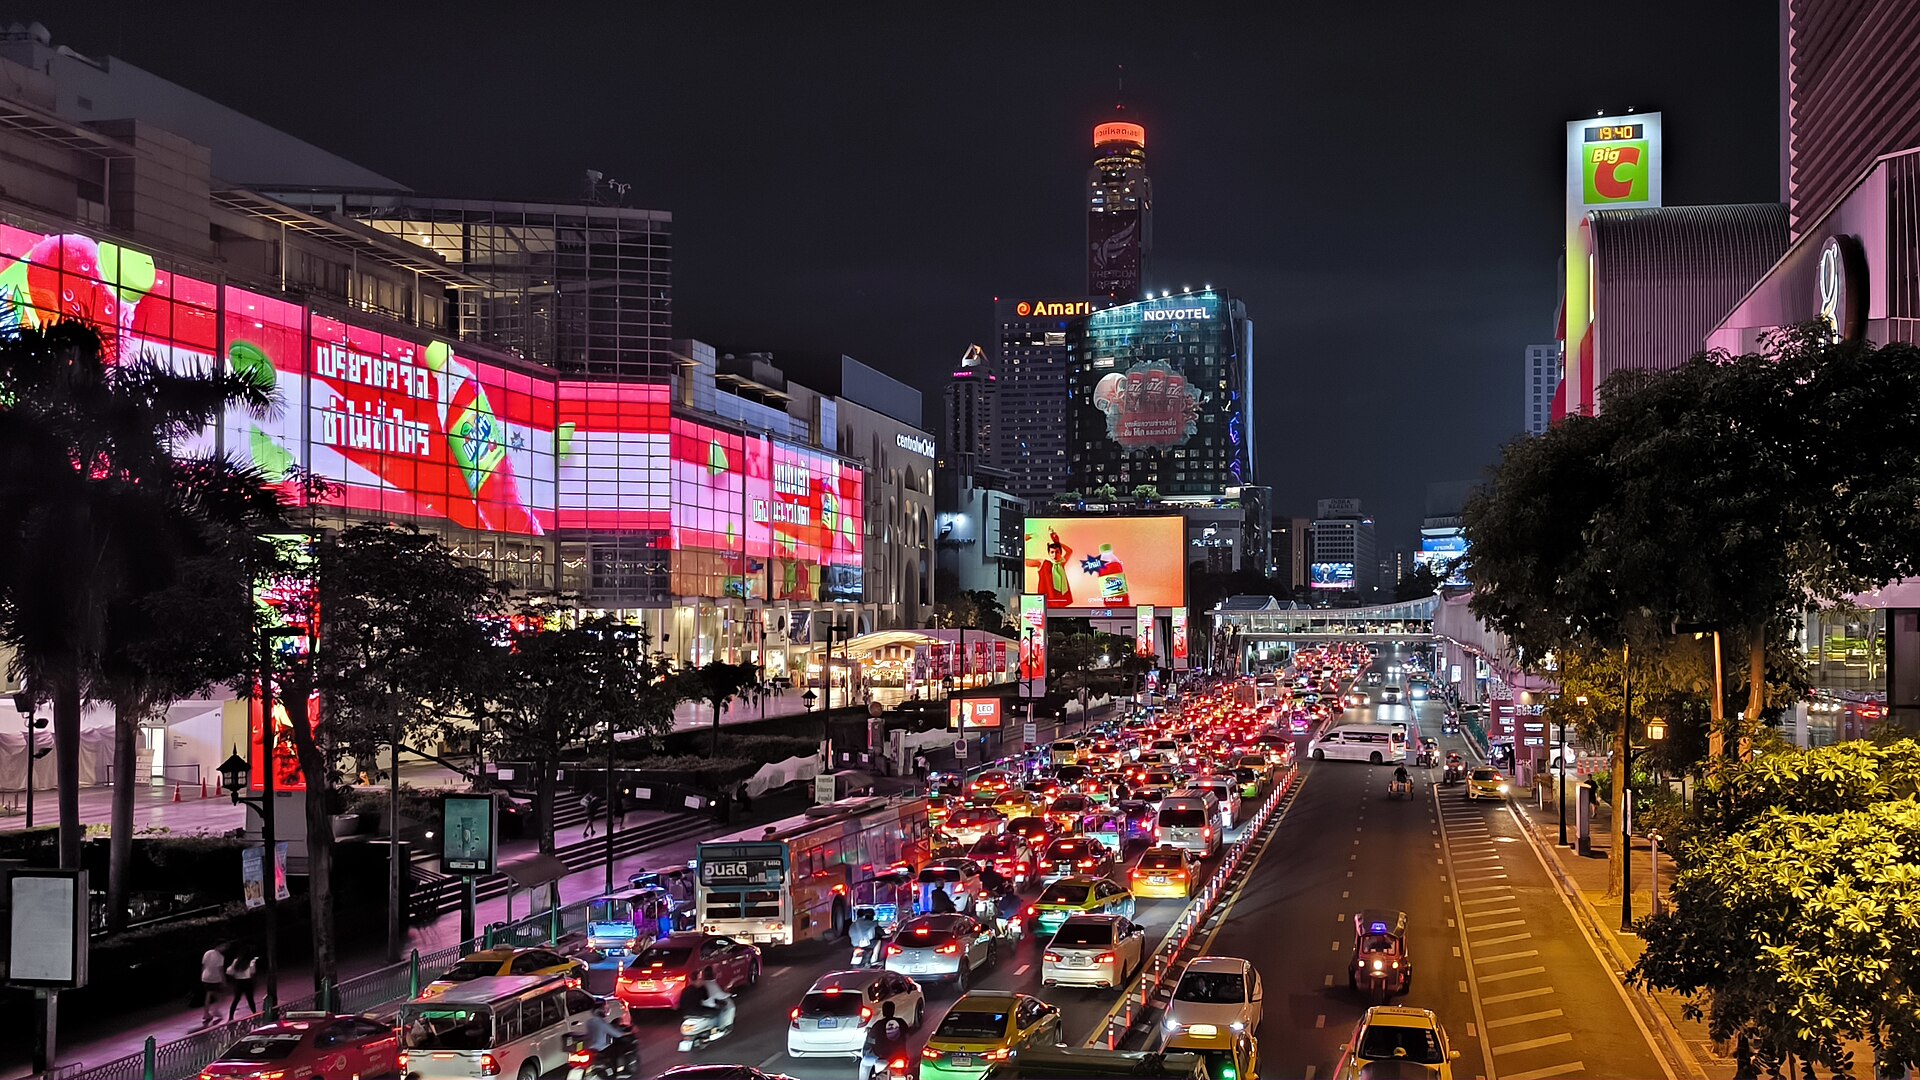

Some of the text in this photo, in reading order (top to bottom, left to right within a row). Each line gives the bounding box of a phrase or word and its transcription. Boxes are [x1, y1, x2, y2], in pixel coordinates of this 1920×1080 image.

[1599, 125, 1633, 140] 19:40
[1591, 147, 1621, 165] Big
[1594, 146, 1641, 199] C
[1033, 301, 1090, 316] Amari
[1143, 306, 1211, 321] NOVOTEL
